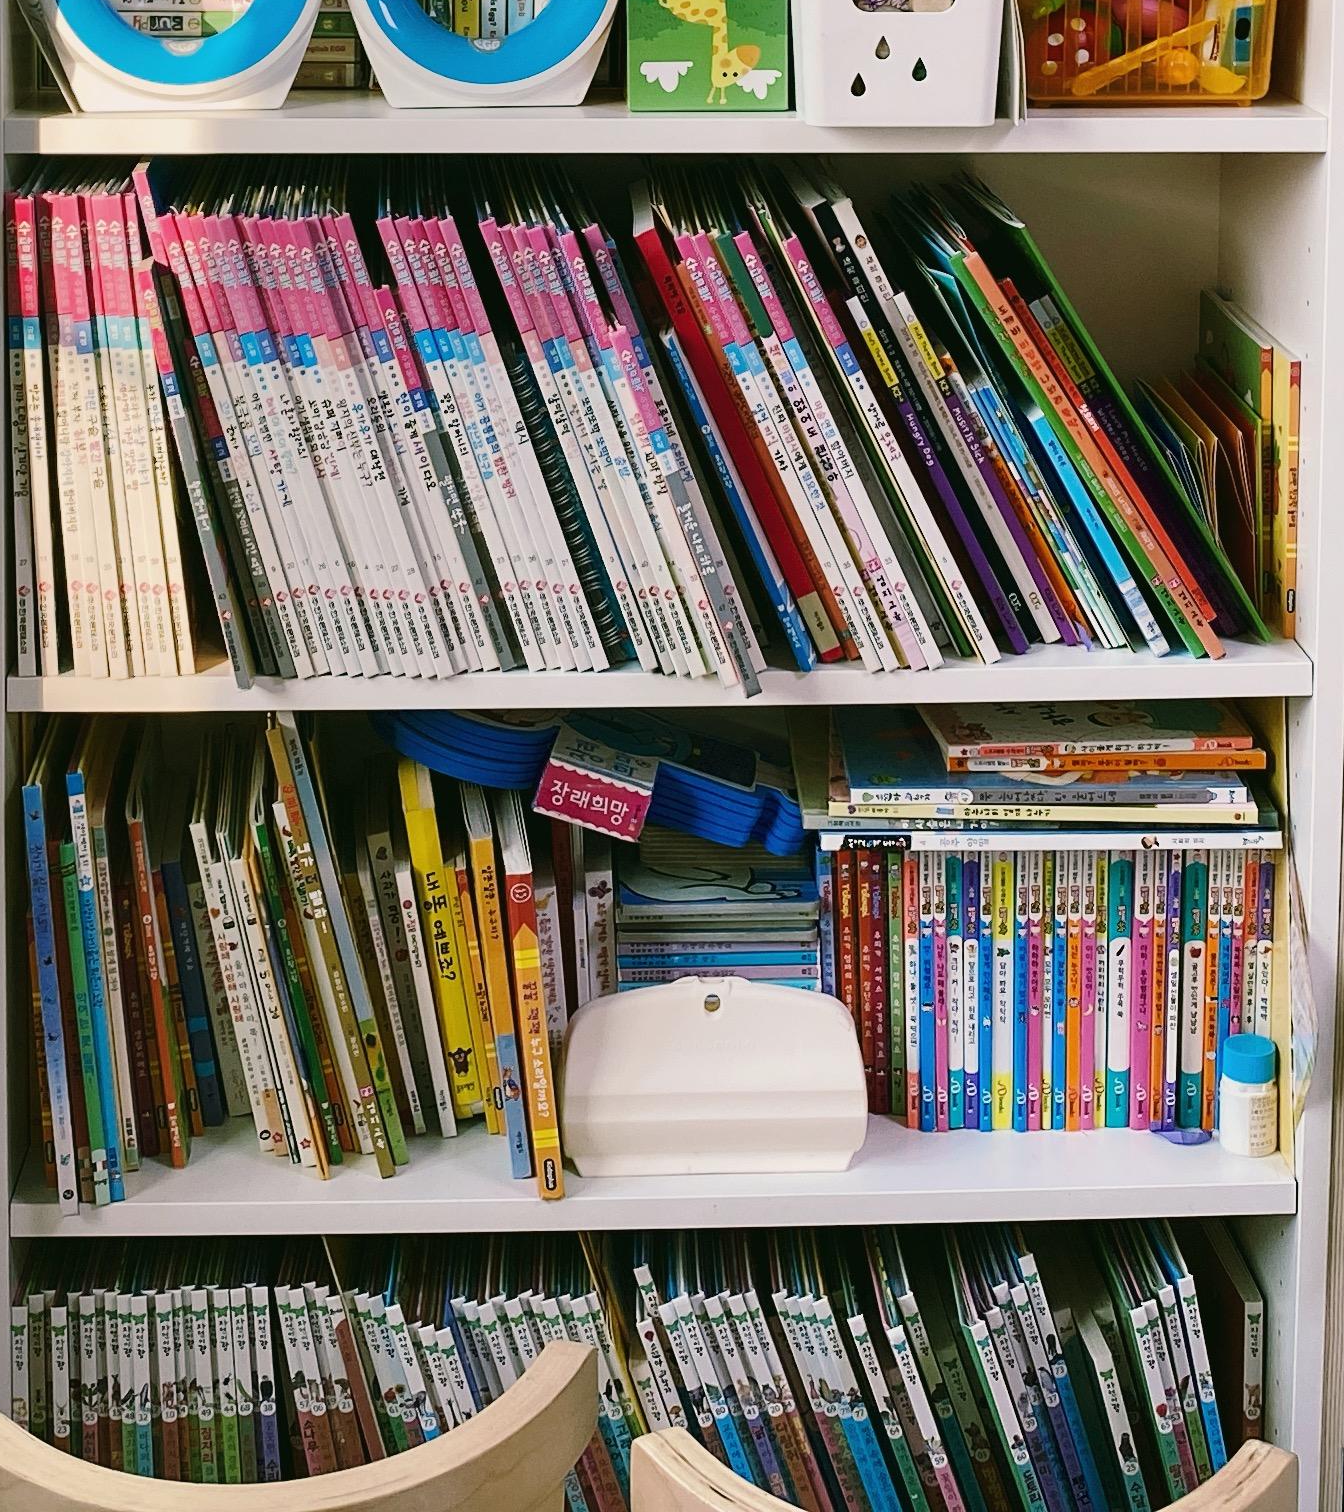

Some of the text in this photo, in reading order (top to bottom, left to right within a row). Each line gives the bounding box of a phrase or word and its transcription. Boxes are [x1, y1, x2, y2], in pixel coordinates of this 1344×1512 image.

[550, 779, 629, 825] 장래희망
[424, 871, 456, 981] 내 똥 예쁘죠?
